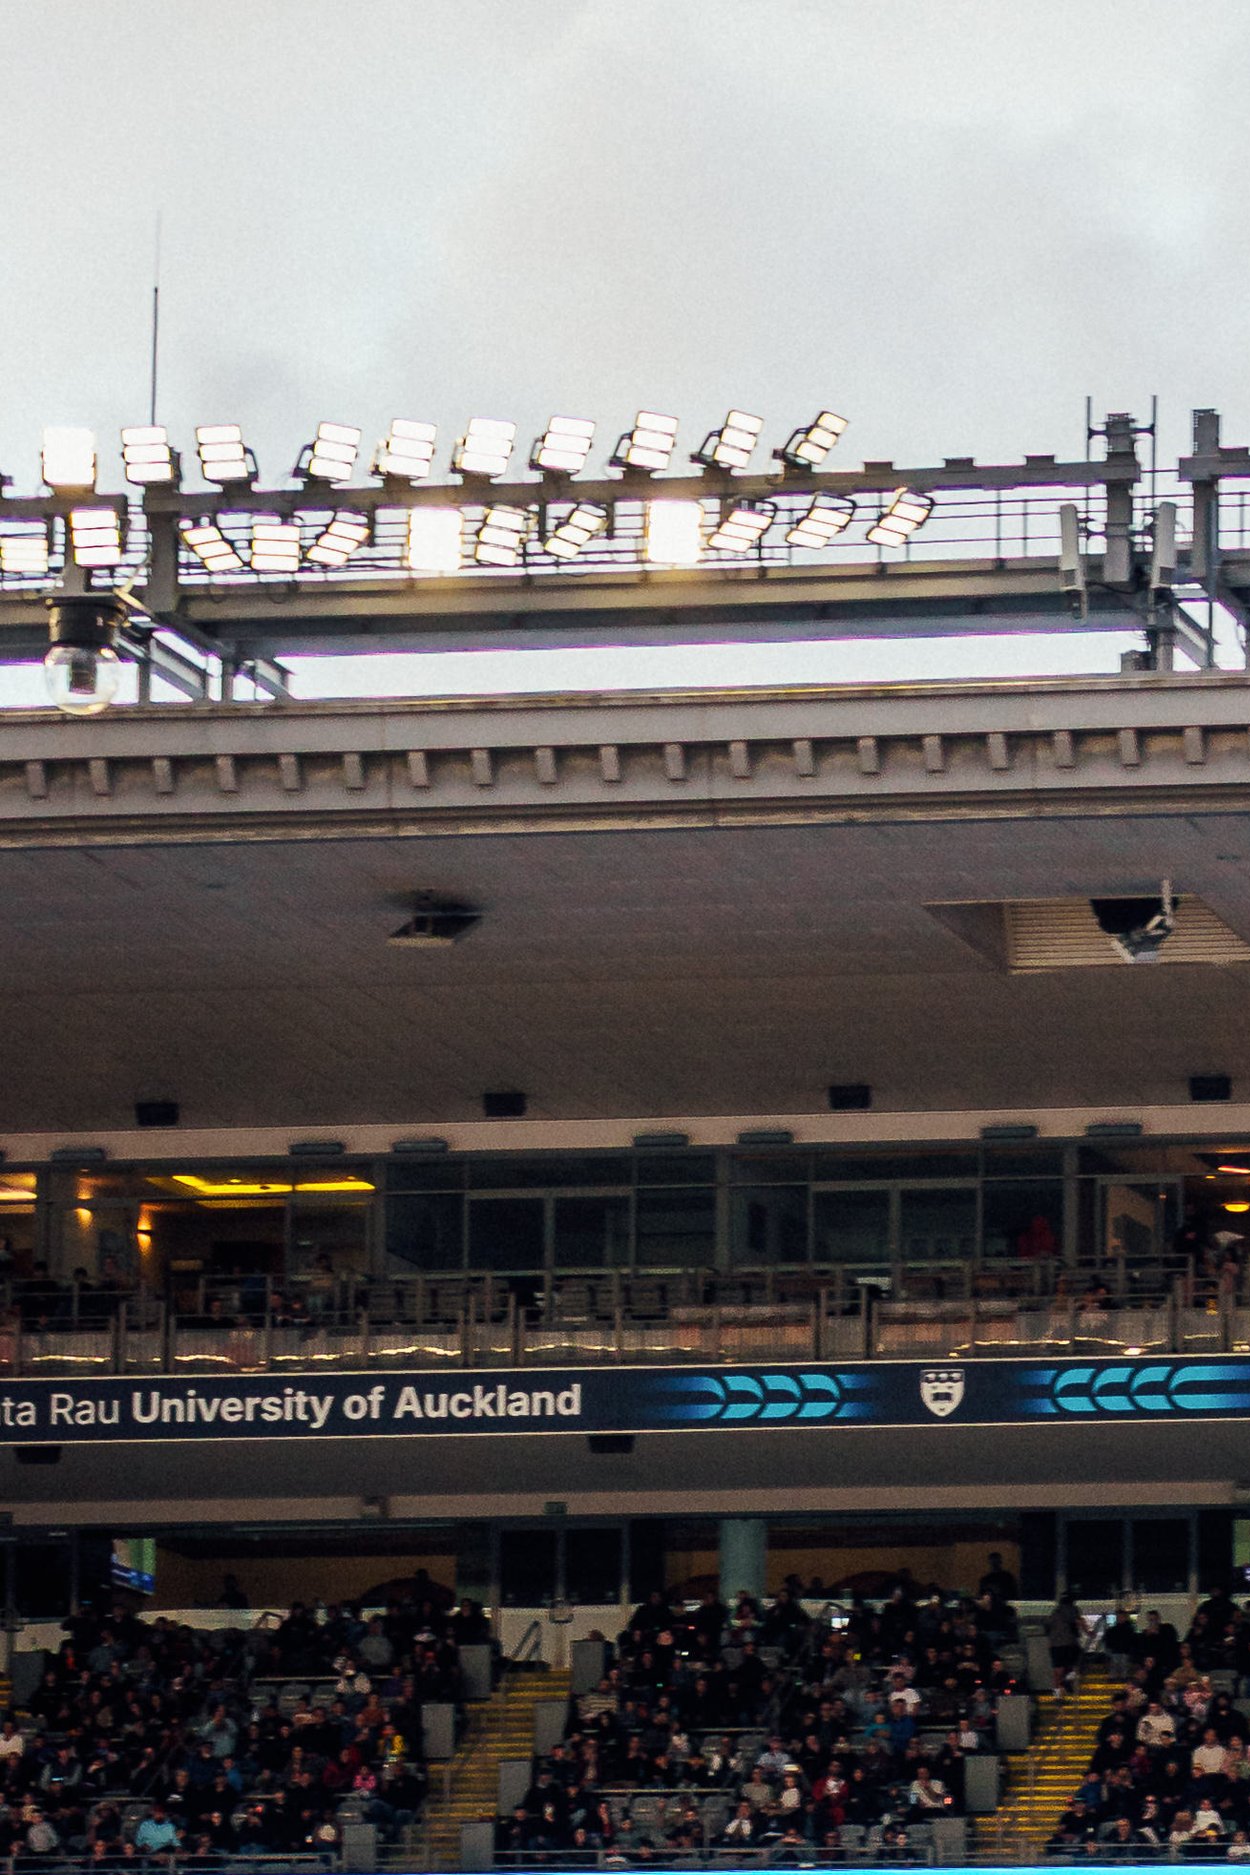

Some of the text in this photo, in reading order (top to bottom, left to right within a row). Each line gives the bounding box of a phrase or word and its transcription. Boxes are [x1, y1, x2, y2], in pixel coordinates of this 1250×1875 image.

[50, 1393, 120, 1426] Rau
[132, 1388, 335, 1430] University
[343, 1386, 386, 1421] of
[393, 1383, 583, 1420] Auckland
